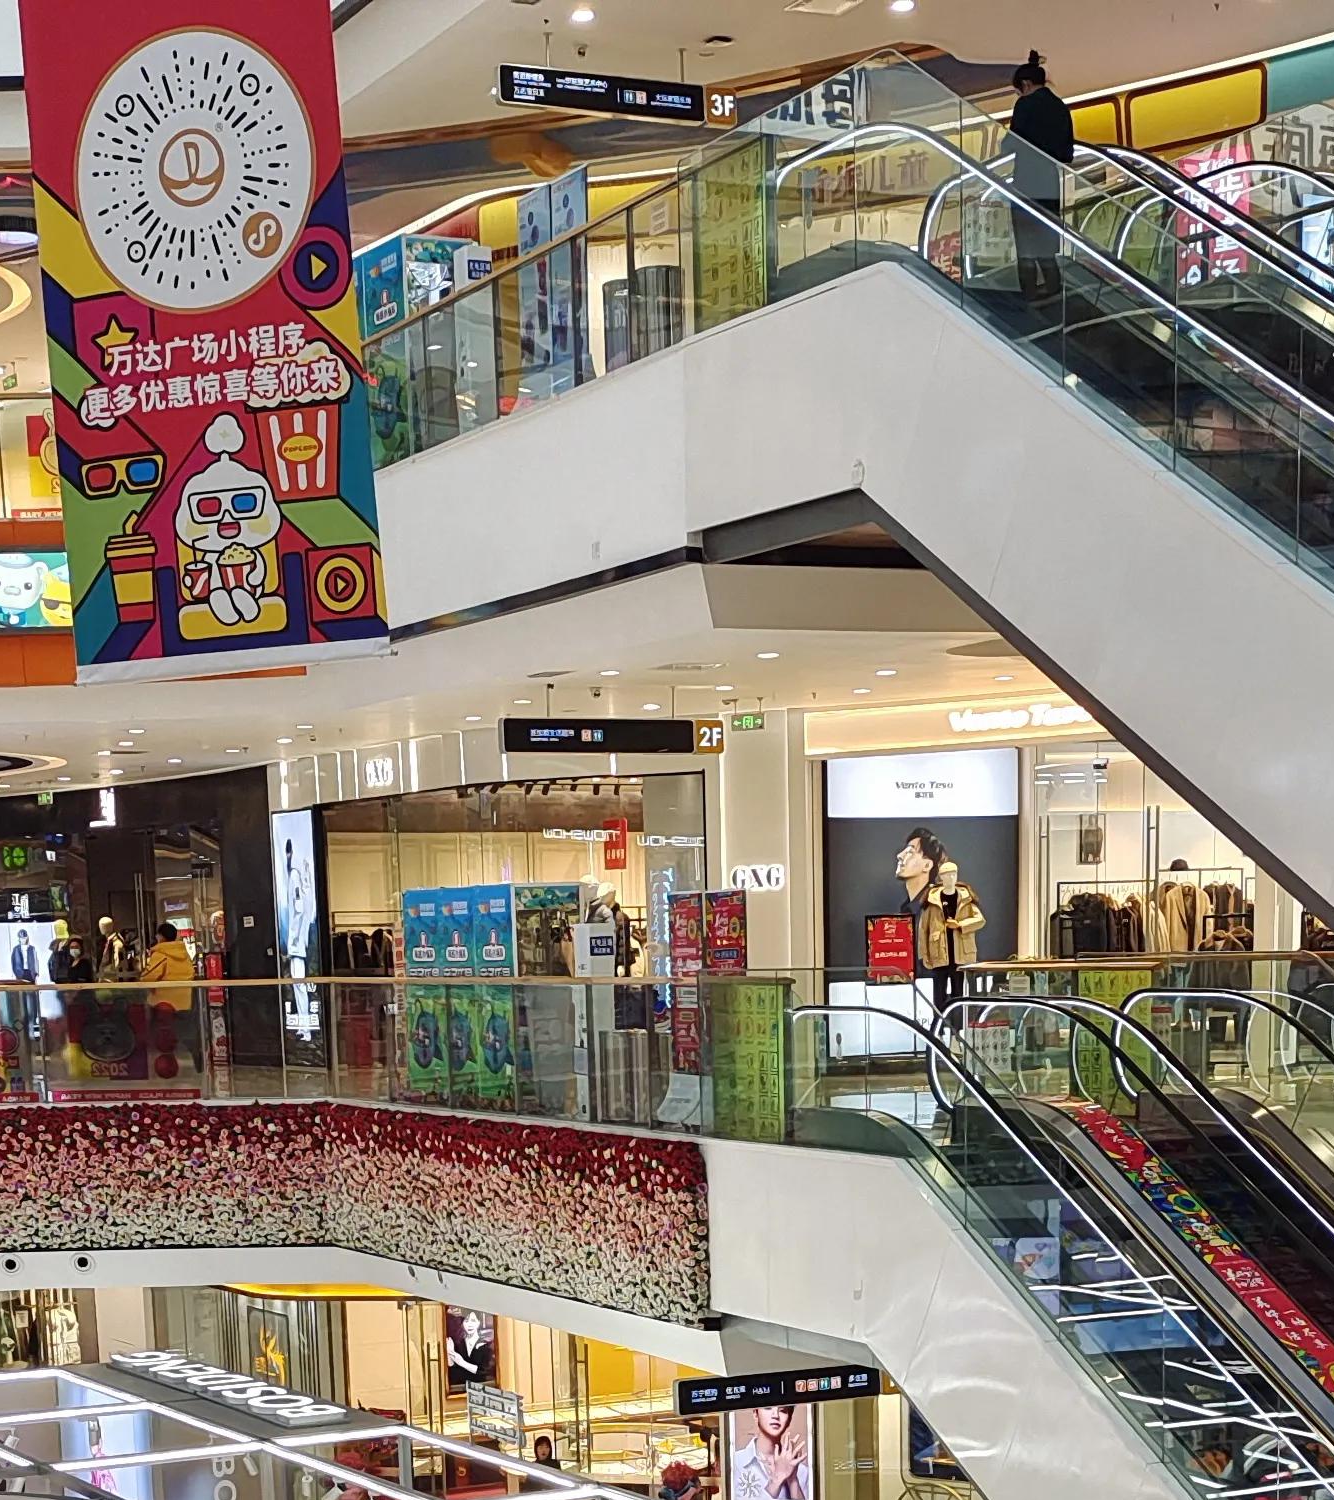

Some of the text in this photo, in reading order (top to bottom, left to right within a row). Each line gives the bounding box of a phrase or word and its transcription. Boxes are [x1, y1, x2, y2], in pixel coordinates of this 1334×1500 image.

[711, 94, 735, 117] 3F
[107, 322, 305, 377] 万达广场小程序
[85, 358, 340, 420] 更多优惠惊喜等你来
[698, 727, 723, 747] 2F
[365, 757, 394, 787] GXG
[731, 863, 786, 893] GXG
[111, 1350, 348, 1421] BOSIDENG
